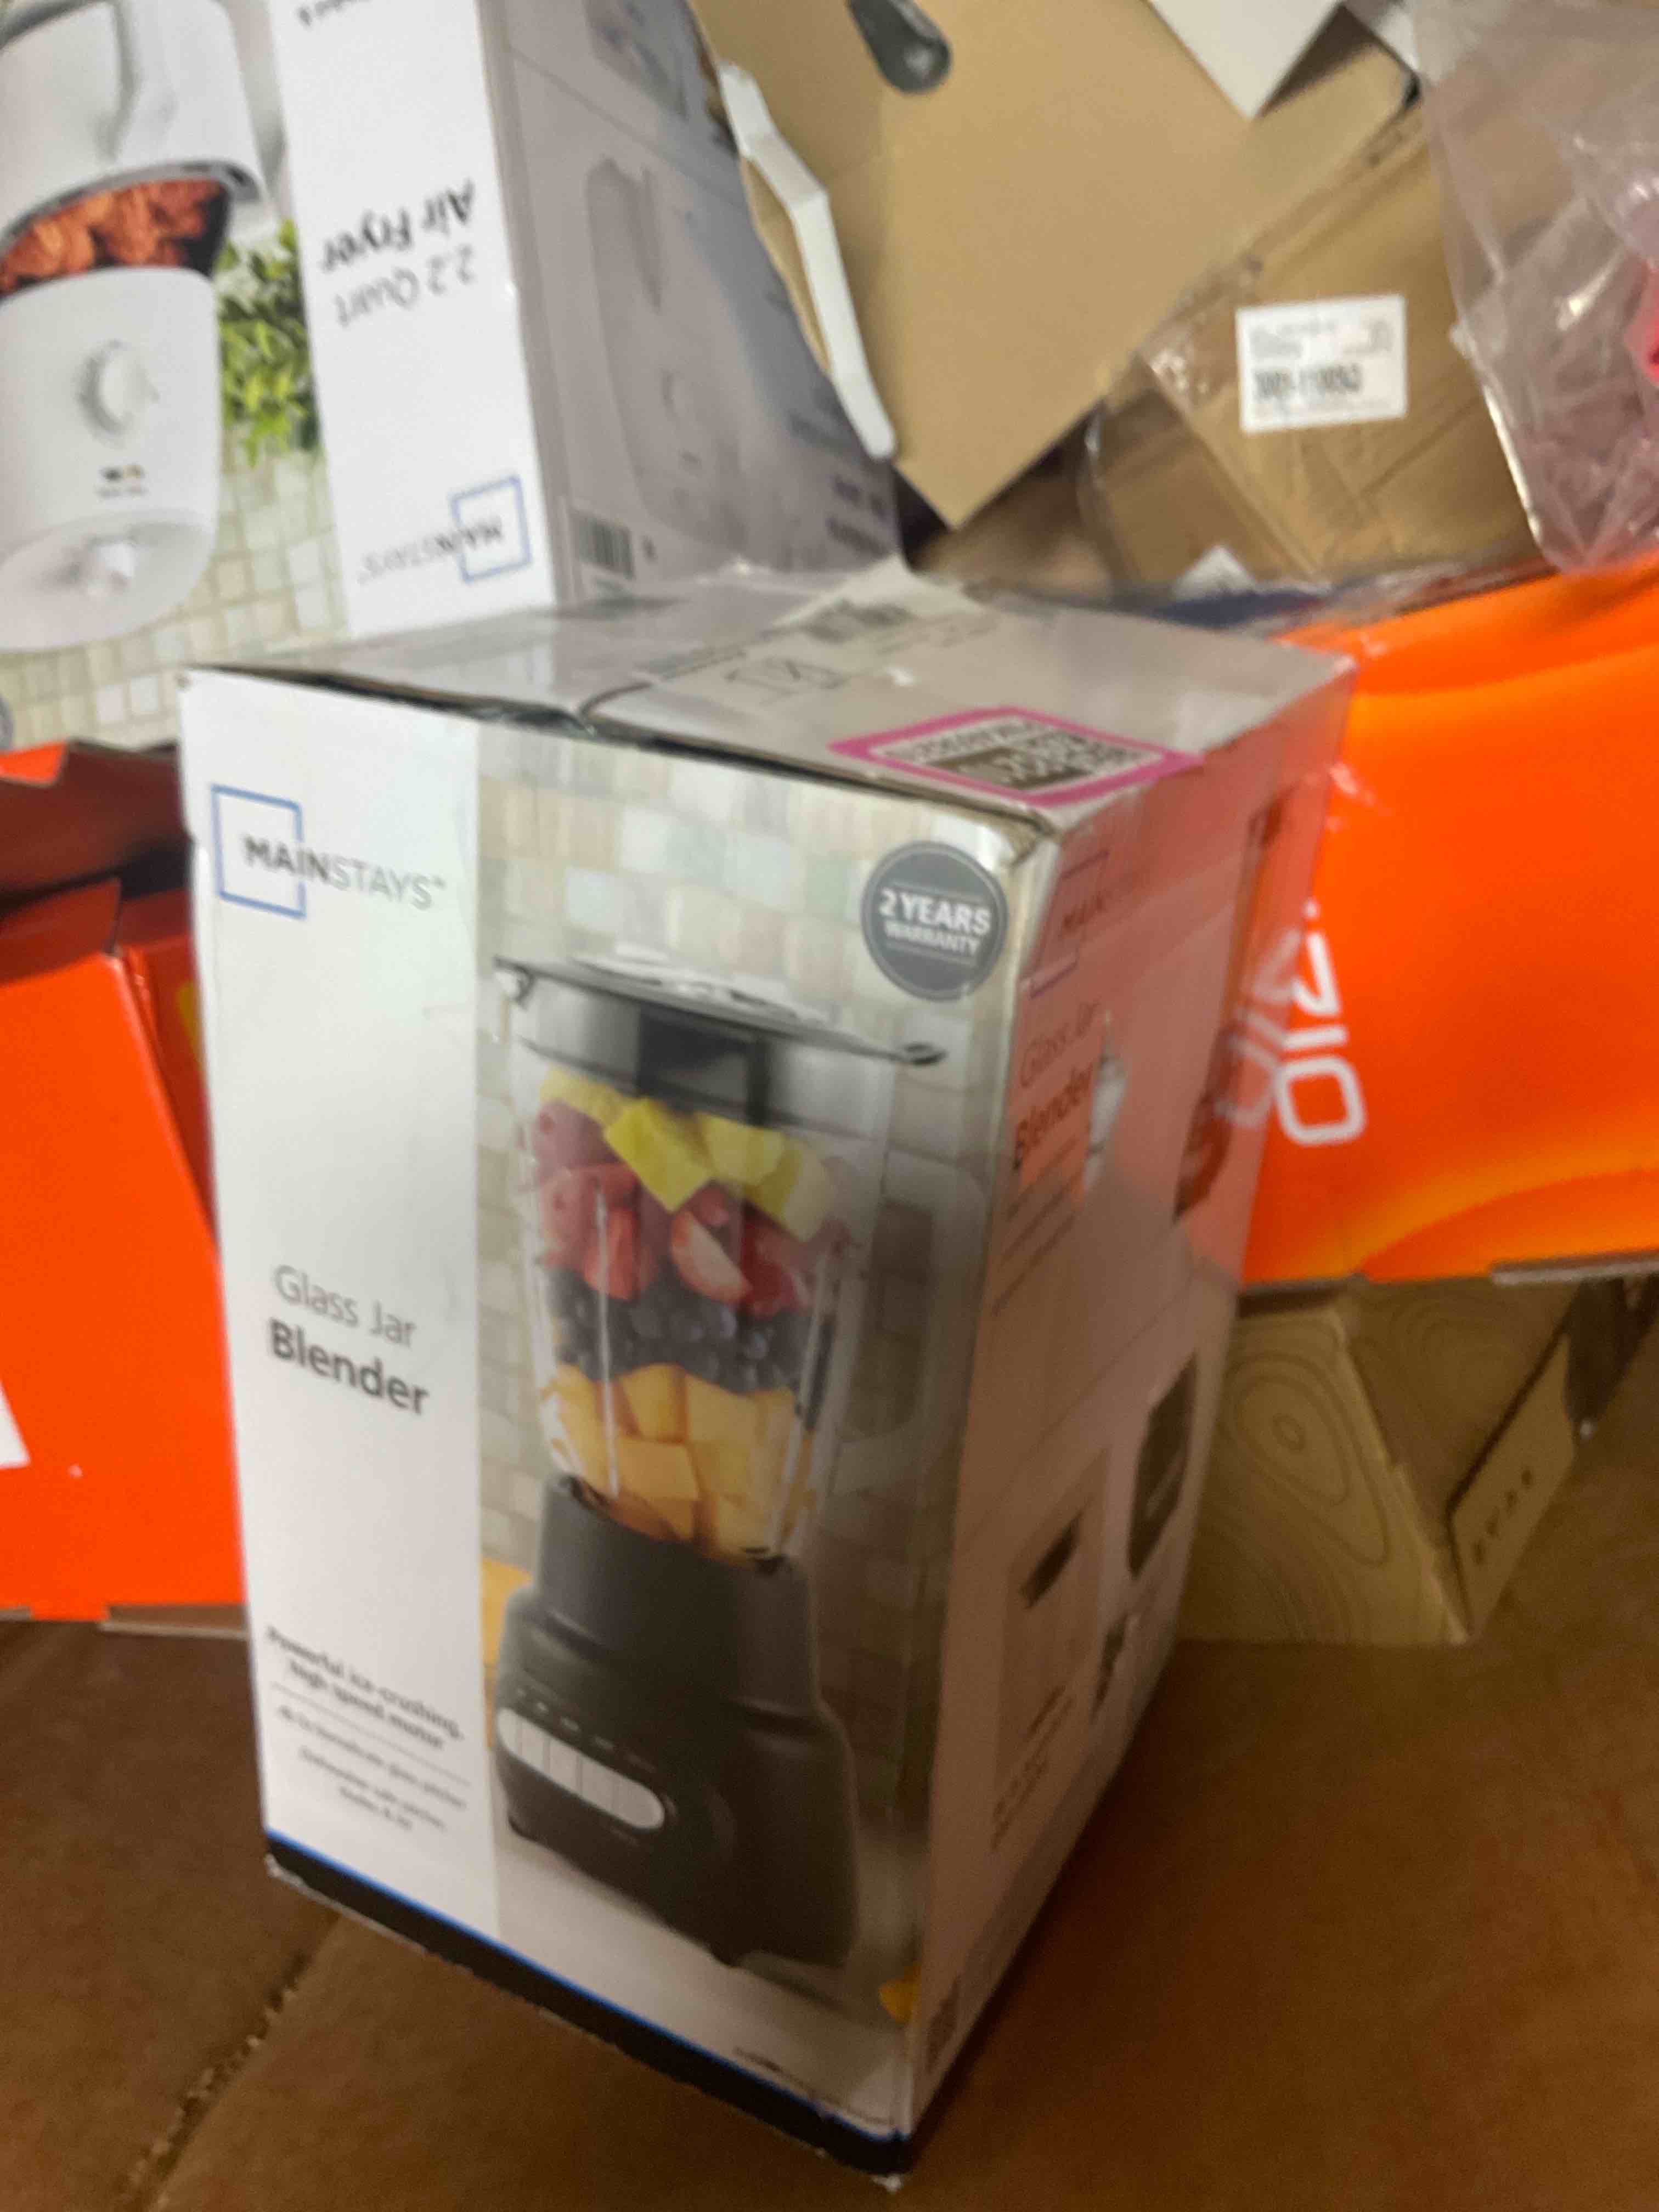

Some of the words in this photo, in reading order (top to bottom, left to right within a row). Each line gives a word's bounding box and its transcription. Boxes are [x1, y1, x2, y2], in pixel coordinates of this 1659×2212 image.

[319, 206, 414, 273] Fryer
[242, 834, 433, 911] MAINSTAYS
[878, 886, 898, 917] 2
[899, 892, 991, 936] YEARS
[274, 1264, 359, 1328] Glass
[369, 1299, 418, 1351] Jar
[269, 1316, 430, 1417] Blender
